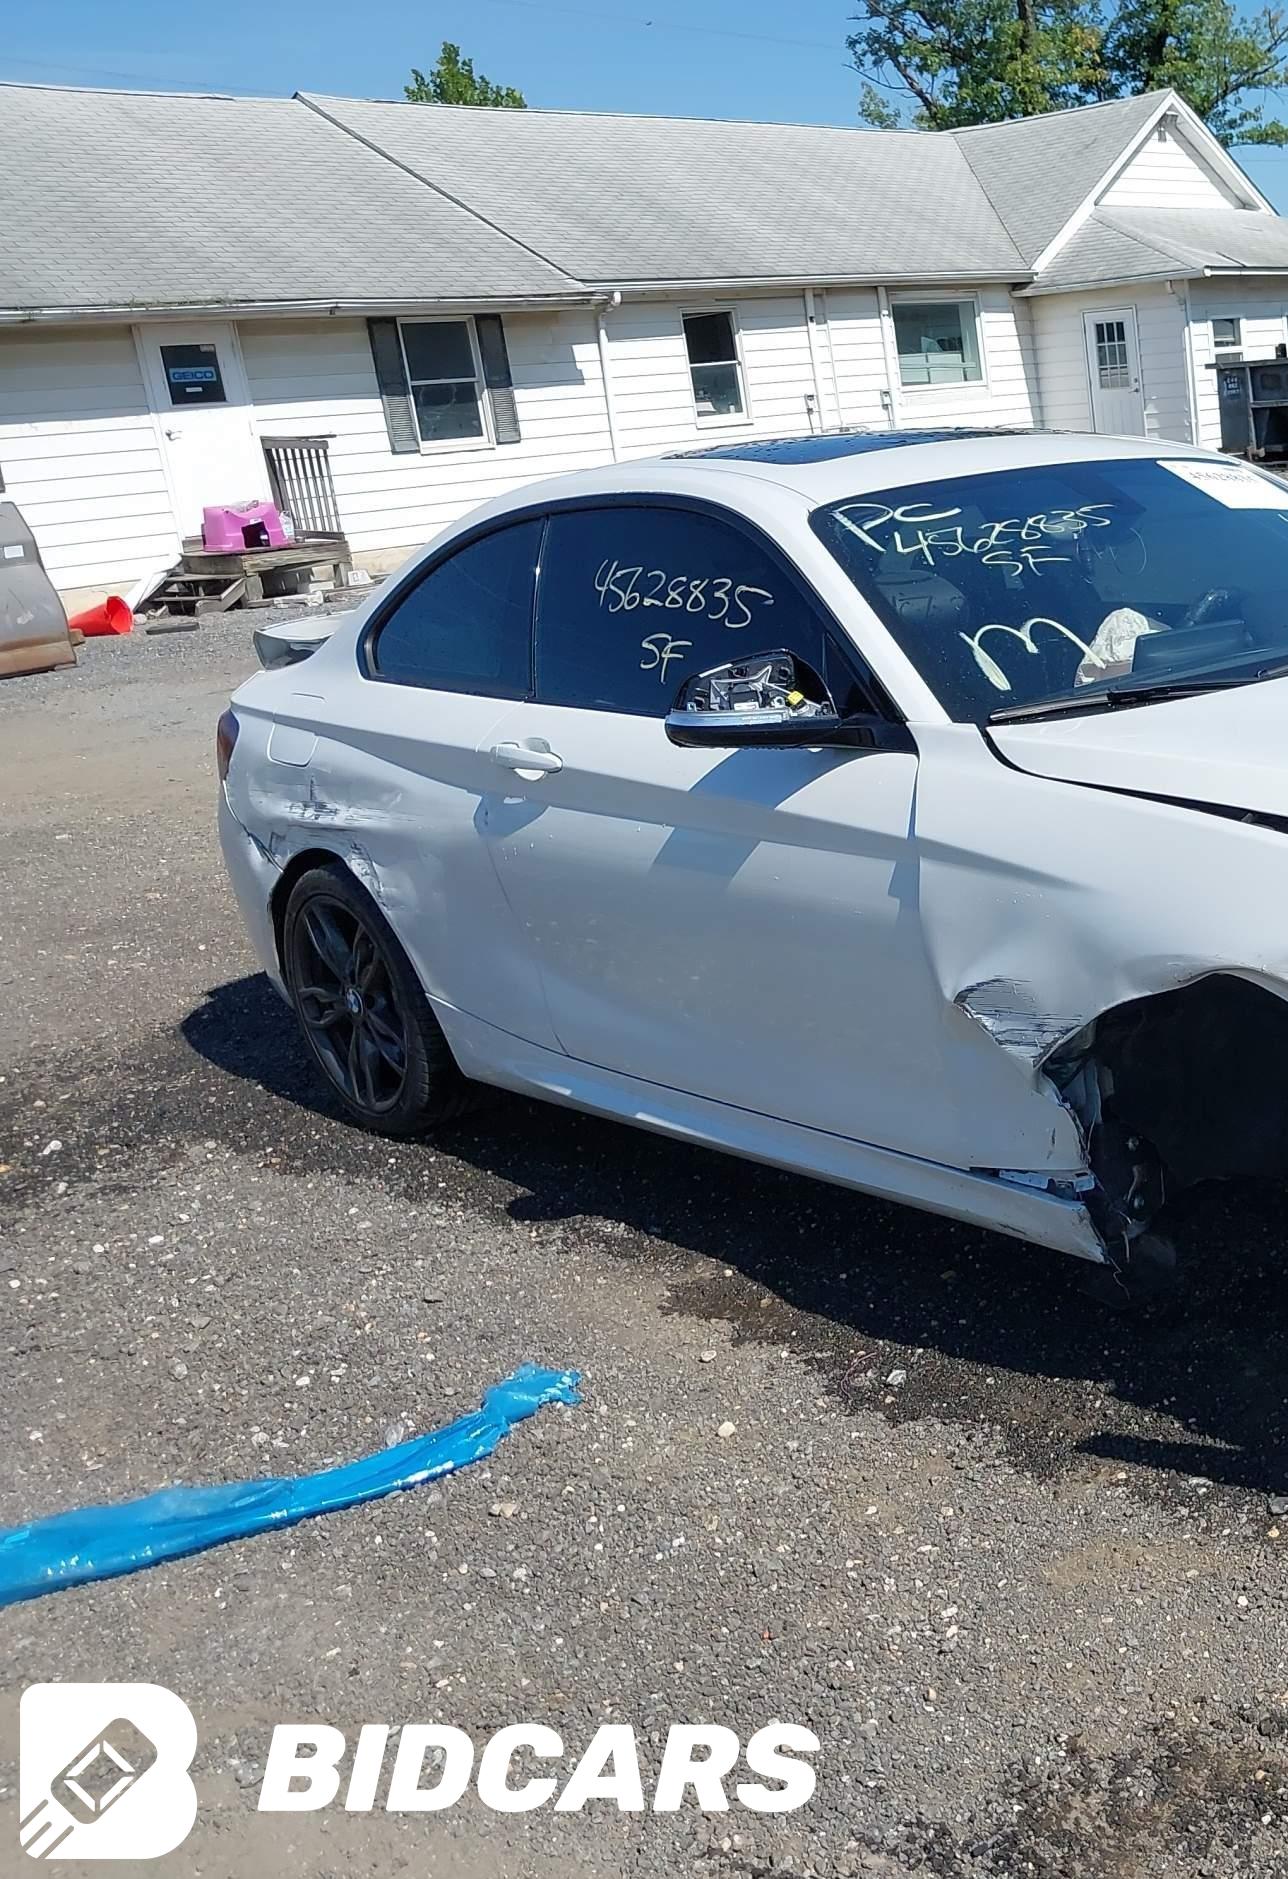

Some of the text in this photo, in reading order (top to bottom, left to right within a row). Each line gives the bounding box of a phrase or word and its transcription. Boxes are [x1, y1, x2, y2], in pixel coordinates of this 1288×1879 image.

[172, 370, 214, 381] GEICO
[894, 504, 1117, 567] 45628835
[981, 544, 1073, 578] SF
[595, 558, 775, 629] 45628835
[640, 632, 693, 685] SF
